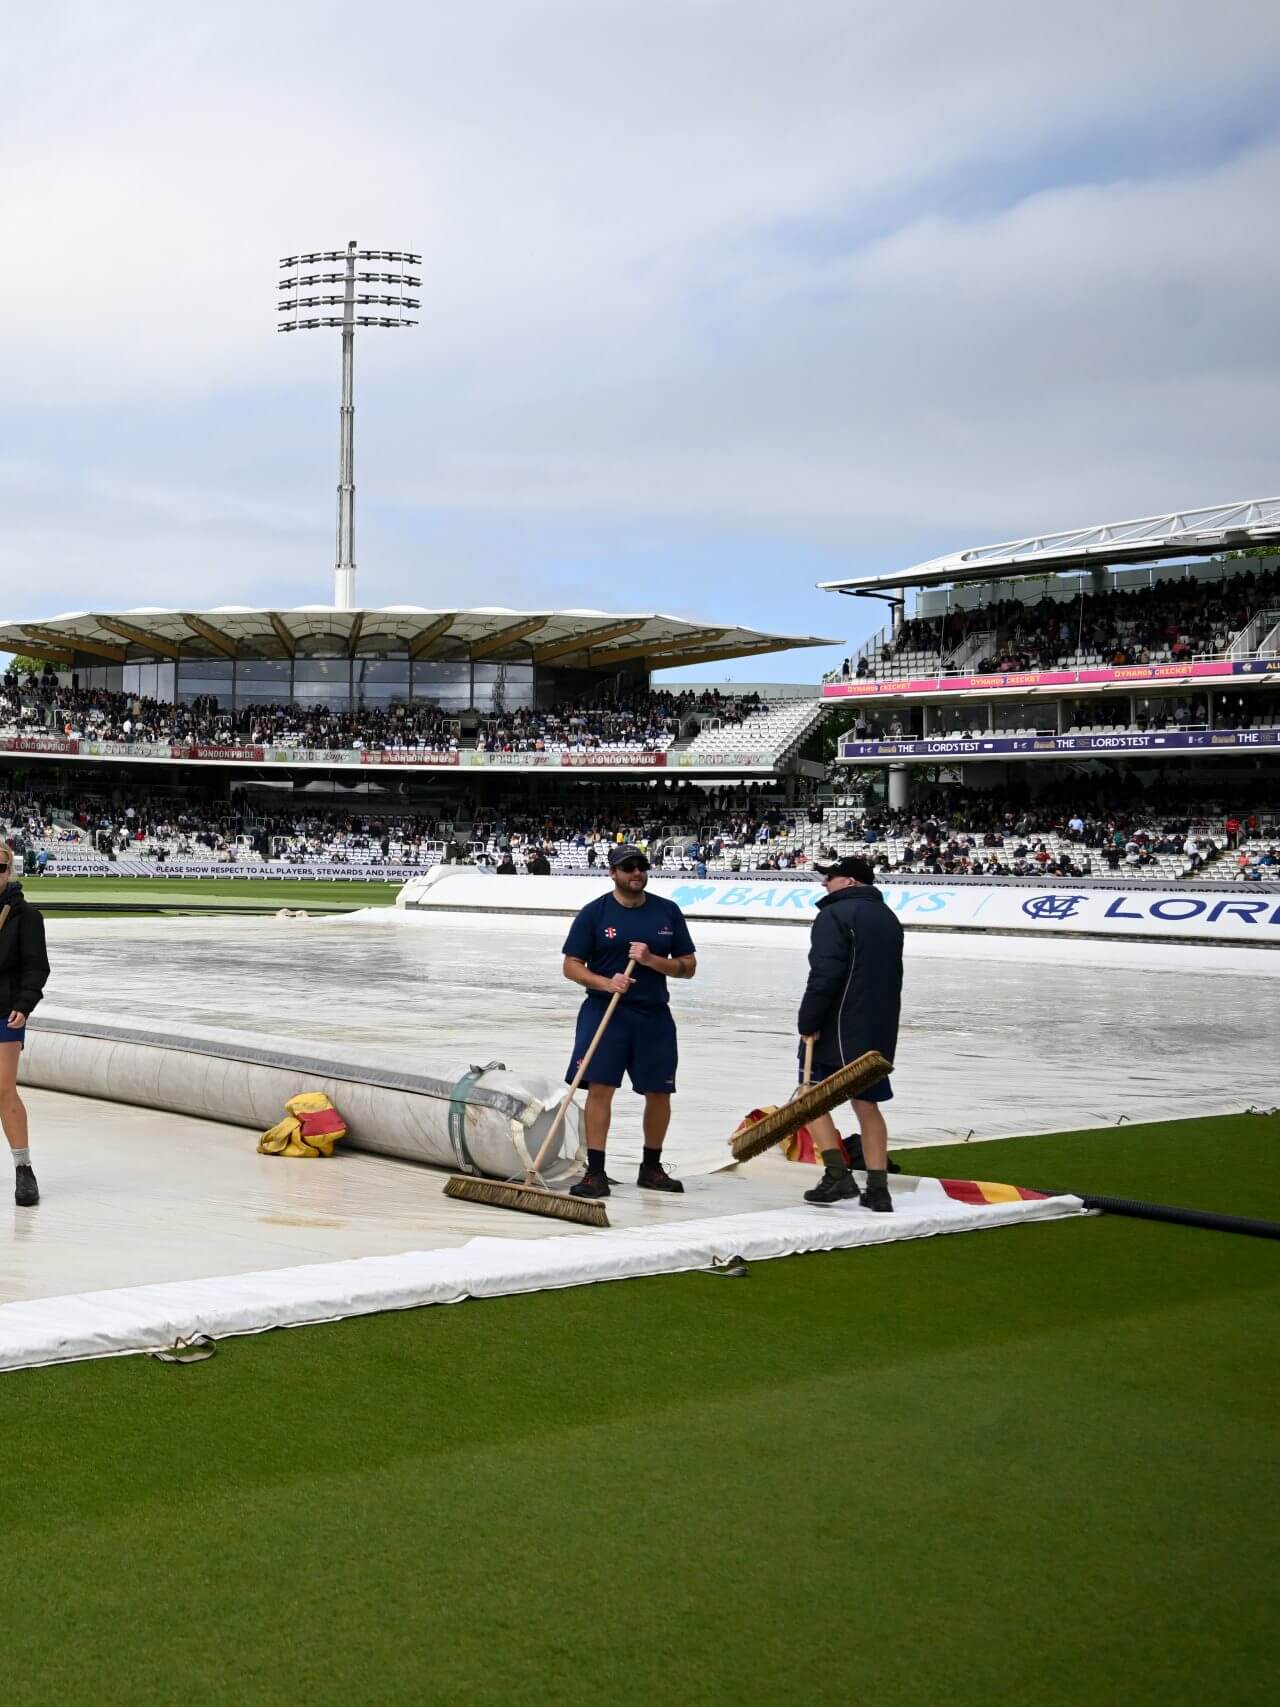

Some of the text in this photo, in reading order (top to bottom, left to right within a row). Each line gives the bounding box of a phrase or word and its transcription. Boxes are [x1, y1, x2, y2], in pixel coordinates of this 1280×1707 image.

[1154, 666, 1193, 676] CRICKET
[1056, 739, 1075, 749] THE
[1091, 737, 1125, 748] LORD'S
[1127, 736, 1150, 746] TEST
[1237, 733, 1259, 743] THE
[15, 741, 70, 752] LONDON PRIDE
[898, 744, 915, 753] THE
[927, 743, 959, 753] LORD'S
[960, 742, 980, 751] TEST
[197, 749, 255, 760] LONDON PRIDE
[698, 754, 729, 766] PRIDE
[56, 864, 109, 872] SPECTATORS
[210, 866, 244, 874] RESPECT
[259, 867, 274, 875] ALL
[276, 868, 315, 876] PLAYERS,
[317, 868, 363, 876] STEWARDS
[366, 869, 384, 877] AND
[1104, 897, 1280, 924] LOR
